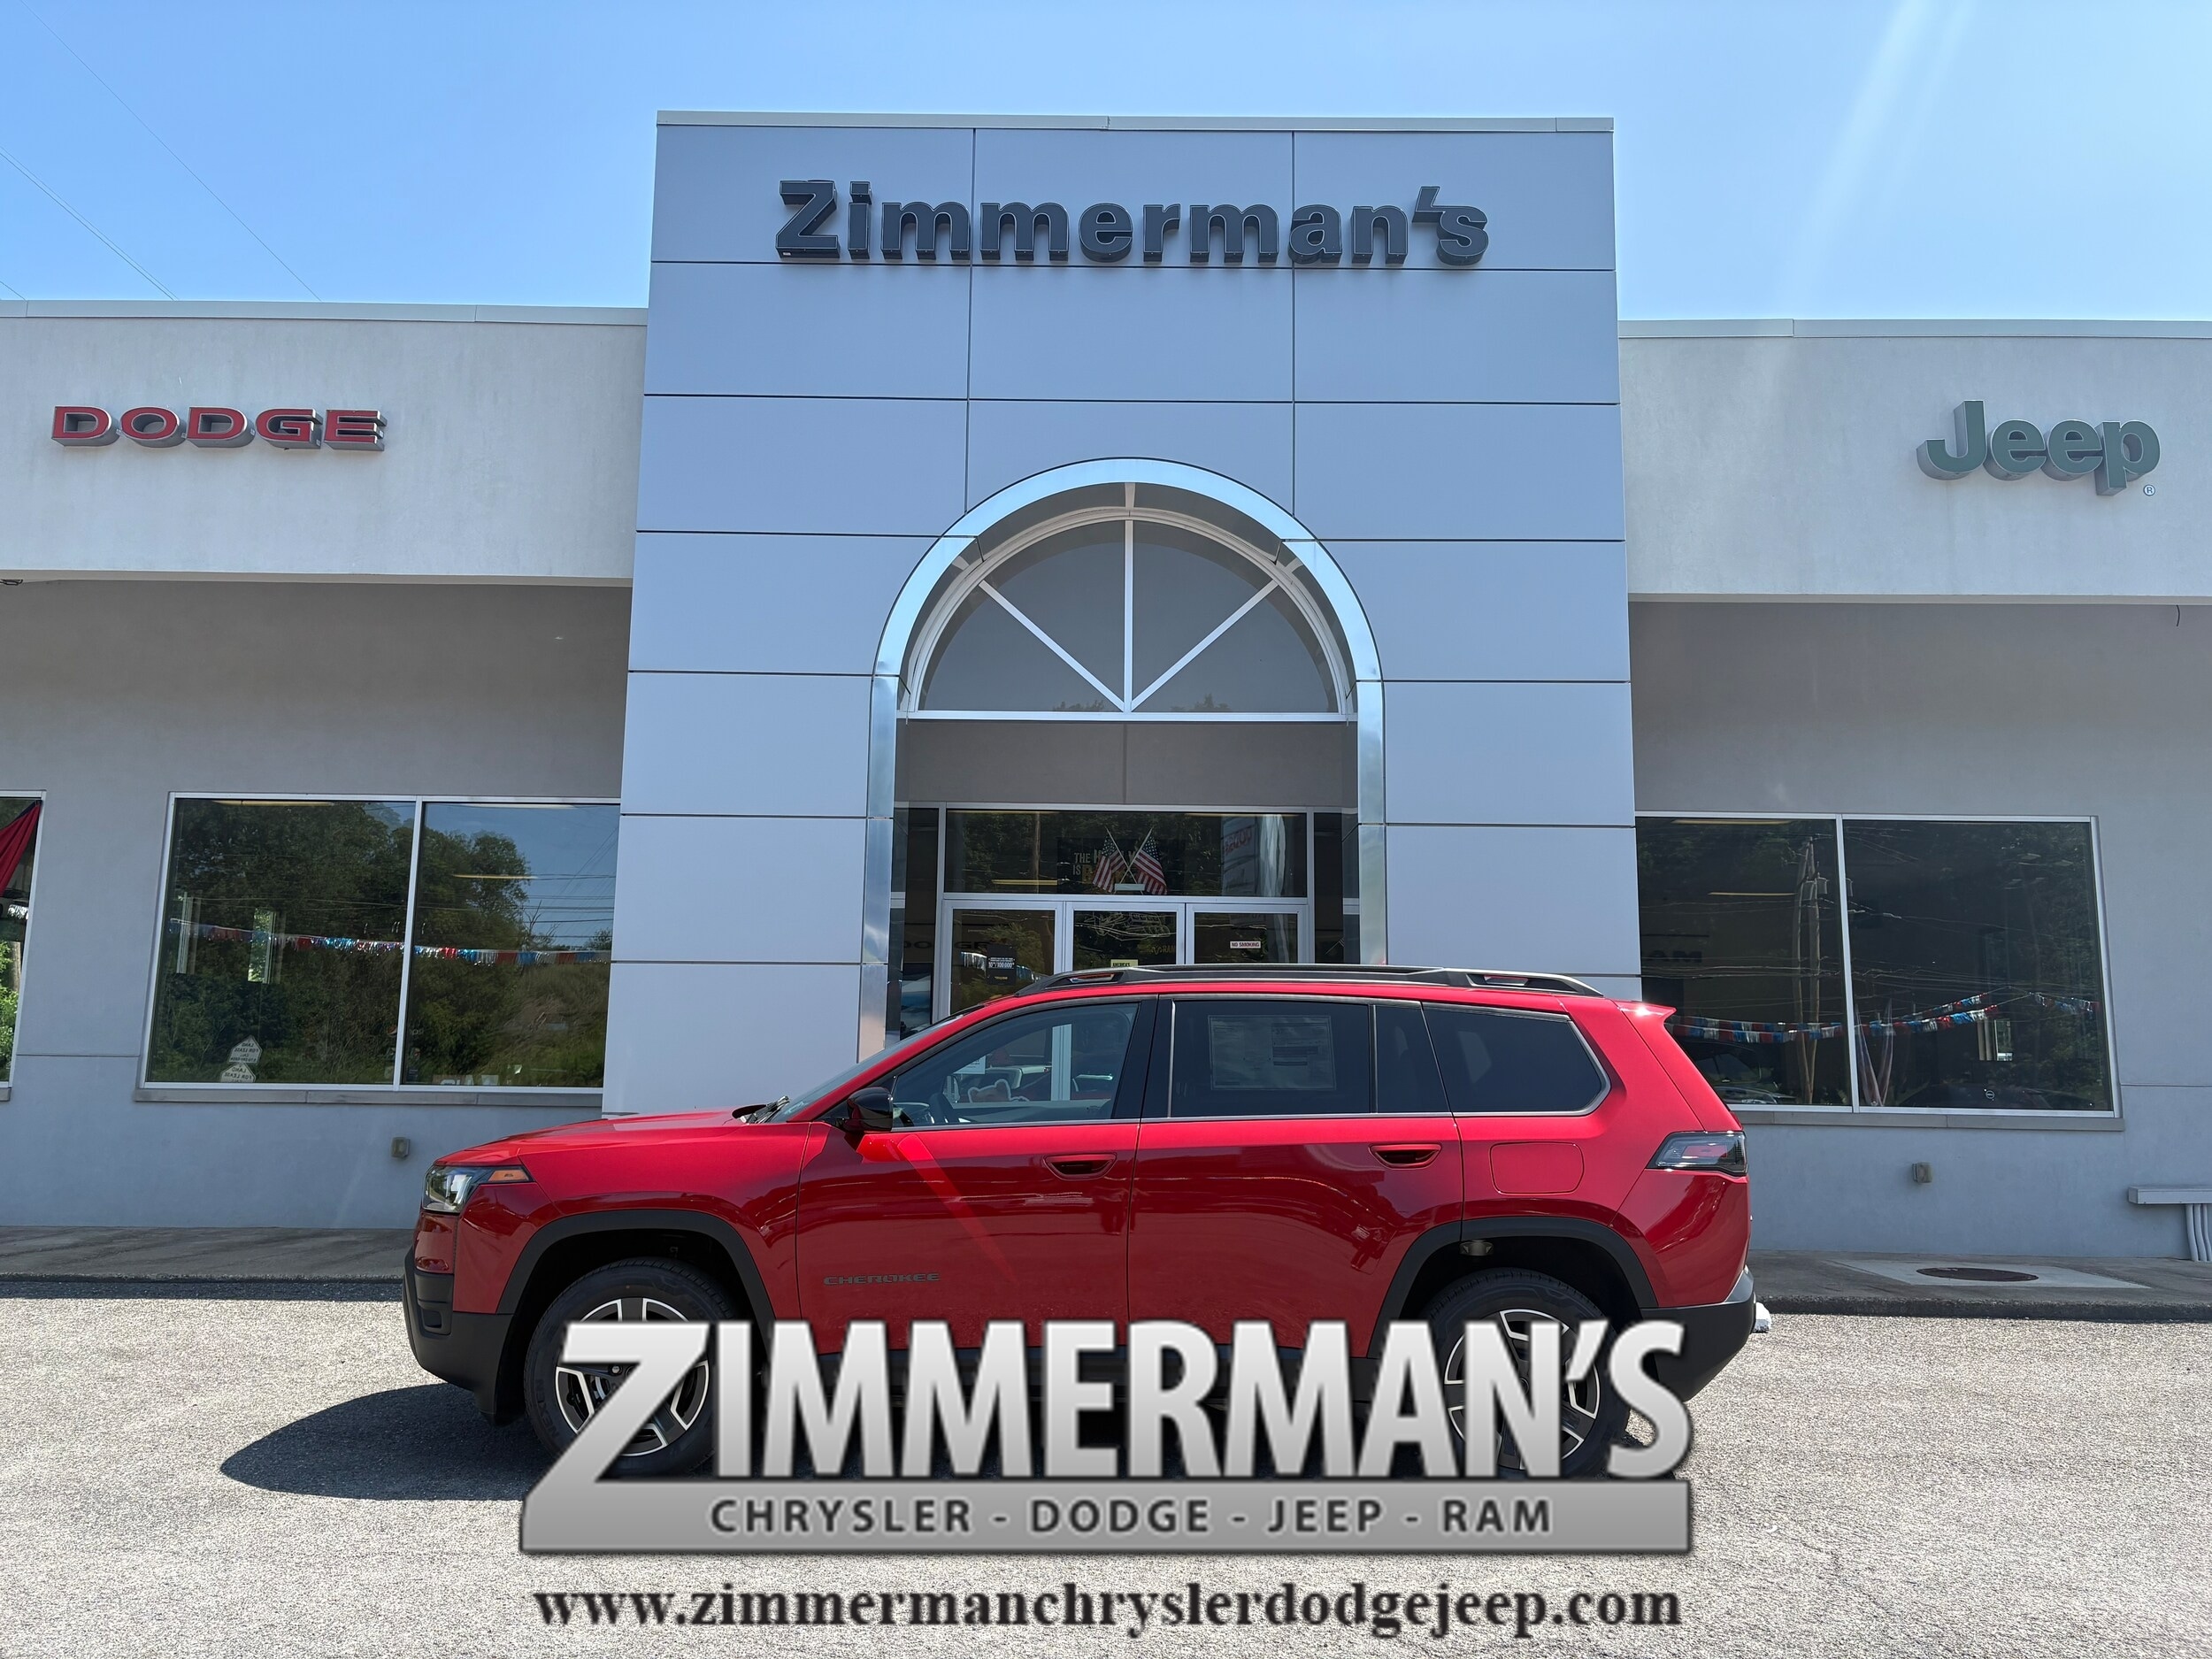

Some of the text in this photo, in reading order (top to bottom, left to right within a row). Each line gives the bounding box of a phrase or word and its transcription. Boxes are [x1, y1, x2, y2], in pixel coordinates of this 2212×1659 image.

[776, 180, 1490, 265] Zimmerman's
[51, 405, 387, 450] DODGE
[1916, 399, 2161, 496] Jeep
[1072, 864, 1081, 875] IS
[1073, 852, 1091, 864] THE
[823, 1272, 941, 1285] CHEROKEE
